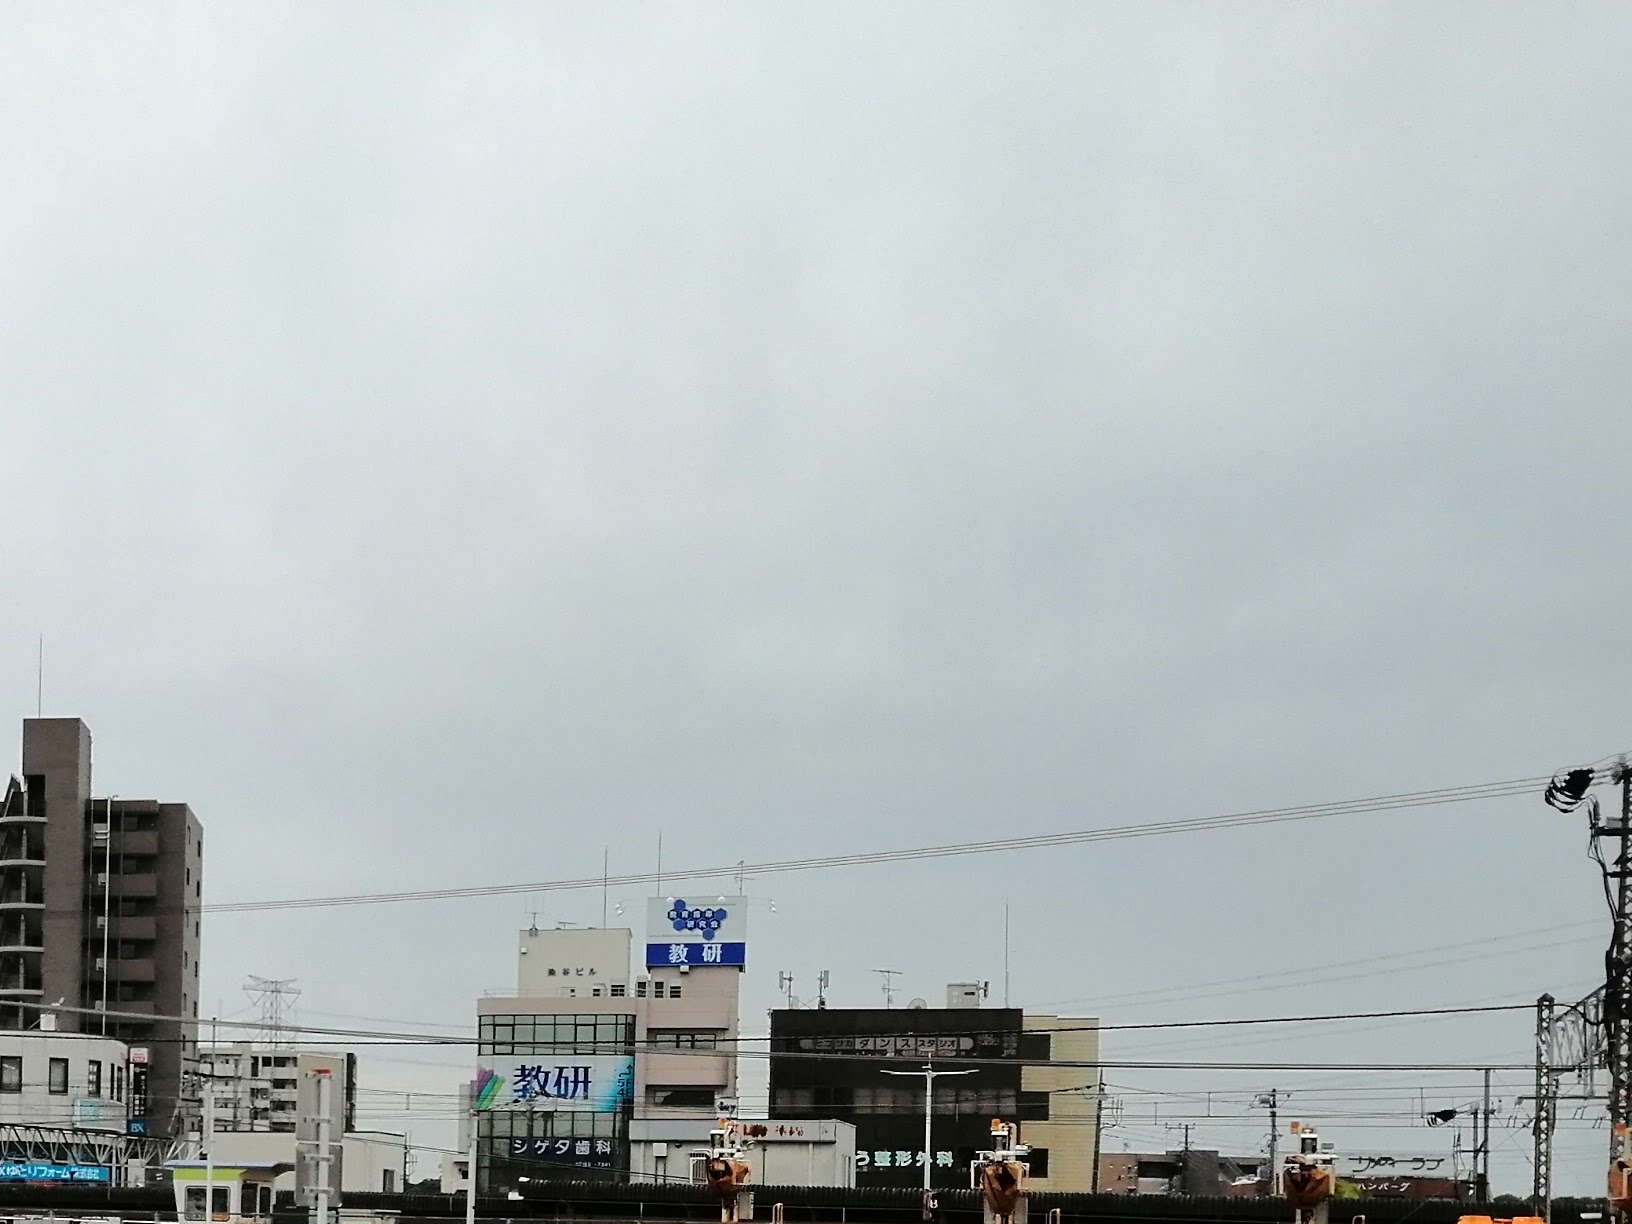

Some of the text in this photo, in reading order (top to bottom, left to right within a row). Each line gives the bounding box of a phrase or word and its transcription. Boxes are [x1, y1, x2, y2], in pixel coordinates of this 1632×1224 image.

[668, 943, 723, 963] 教研
[513, 1064, 592, 1099] 教研
[513, 1139, 611, 1155] シゲタ歯科
[1357, 1182, 1411, 1192] ハンバーグ
